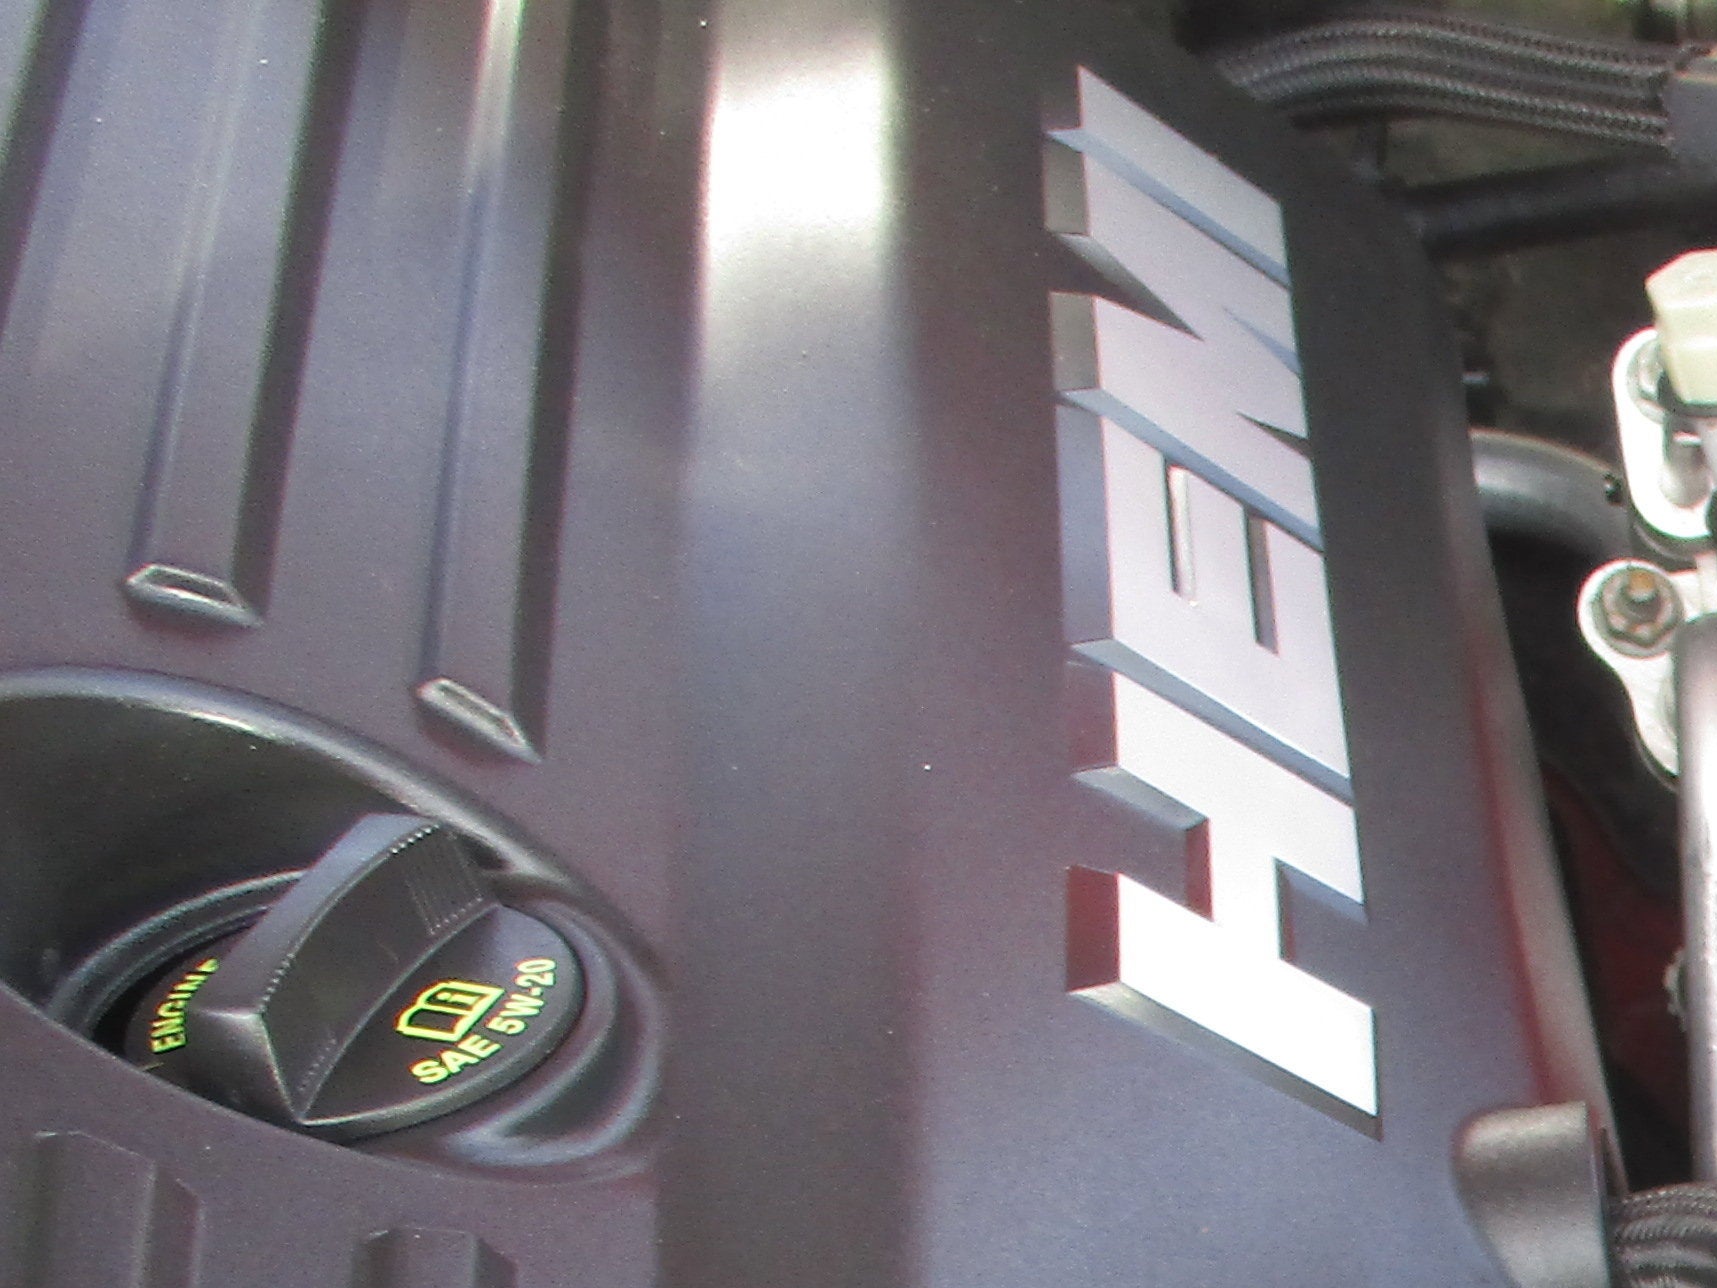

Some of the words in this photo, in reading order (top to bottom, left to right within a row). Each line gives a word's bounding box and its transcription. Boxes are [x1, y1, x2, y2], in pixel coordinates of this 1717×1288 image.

[1060, 65, 1381, 1122] HEMI
[411, 1033, 502, 1085] SAE
[485, 957, 558, 1037] 5W-20
